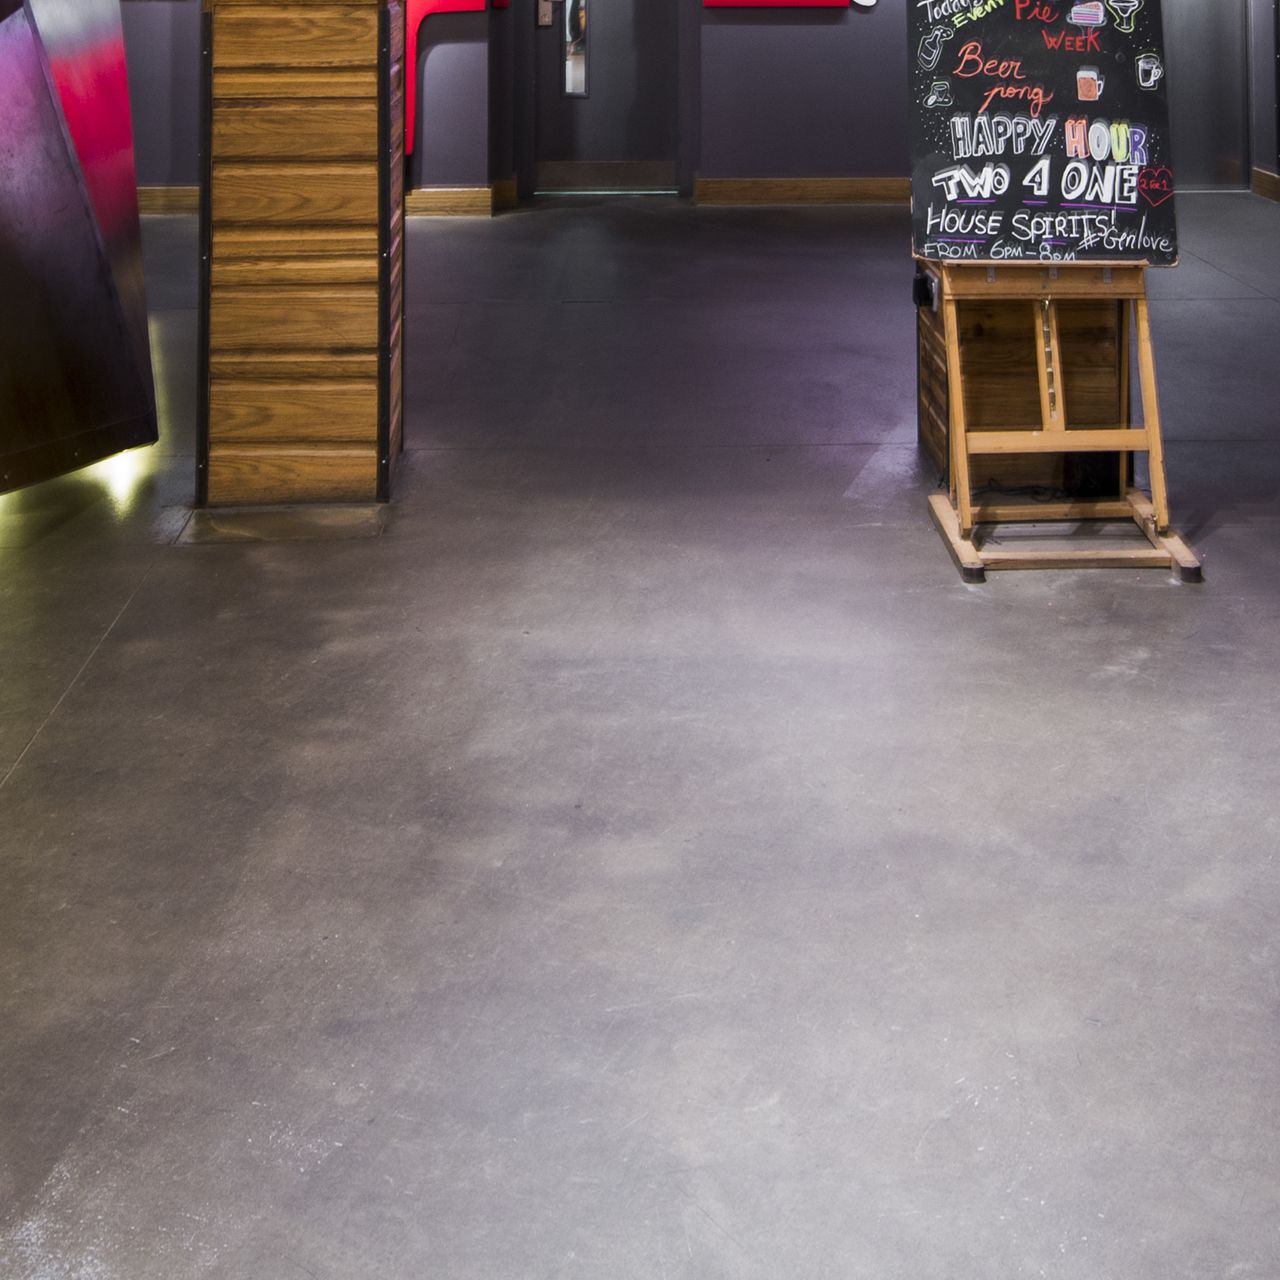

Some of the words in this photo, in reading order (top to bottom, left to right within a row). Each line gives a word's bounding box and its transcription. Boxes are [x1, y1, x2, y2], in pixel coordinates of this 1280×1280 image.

[1042, 27, 1101, 52] WEEK
[953, 41, 1026, 79] Beer
[978, 86, 1053, 118] pong
[950, 116, 1056, 160] HAPPY
[1065, 119, 1148, 165] HOUR
[932, 166, 1009, 201] TWO
[1022, 157, 1050, 196] 4
[1061, 162, 1139, 204] ONE
[927, 205, 1002, 235] HOUSE
